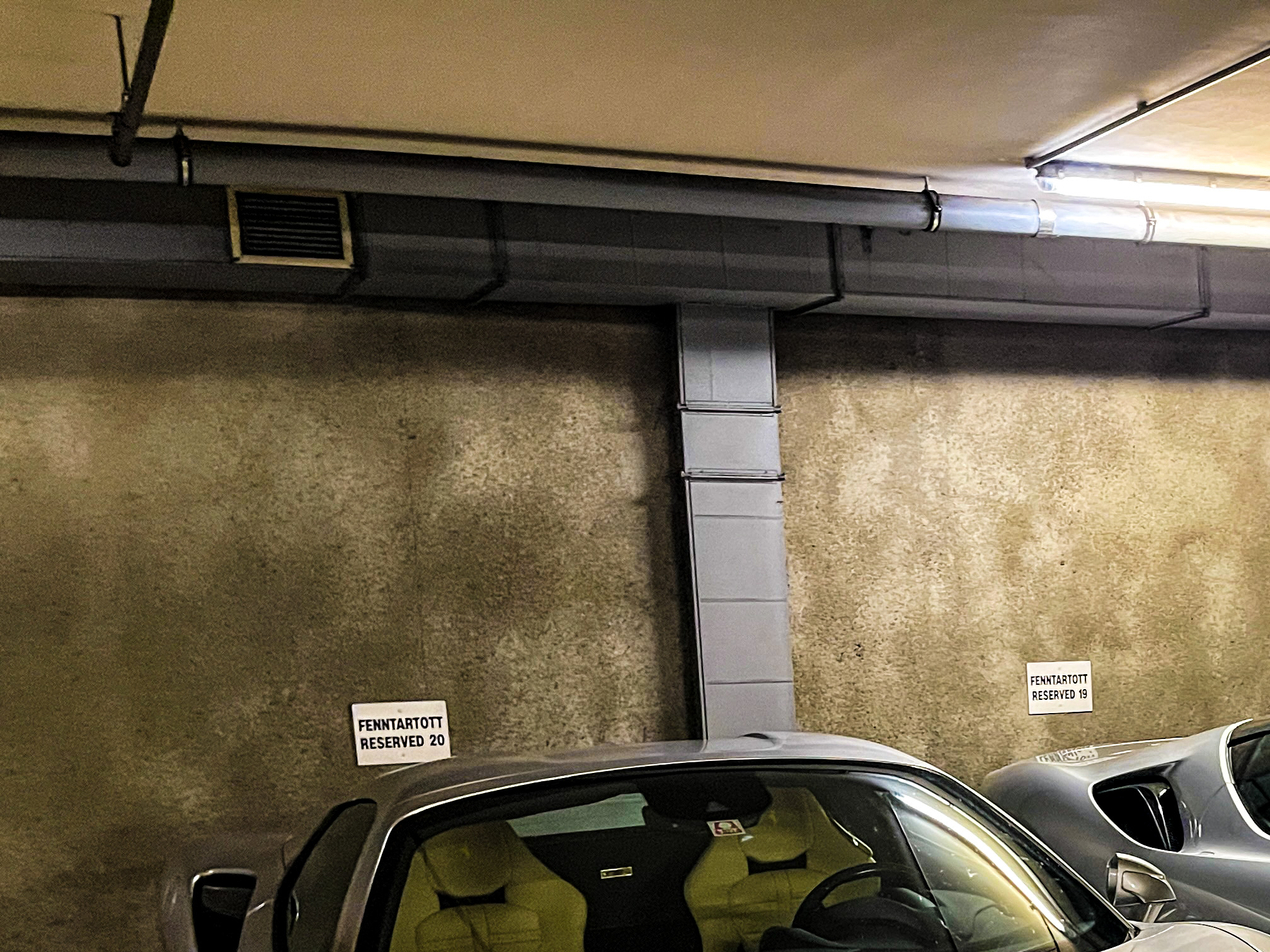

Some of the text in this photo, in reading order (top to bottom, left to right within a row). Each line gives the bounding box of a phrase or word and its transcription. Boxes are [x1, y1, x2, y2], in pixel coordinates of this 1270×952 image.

[1030, 673, 1088, 686] FENNTARTOTT
[1032, 688, 1088, 701] RESERVED 19
[358, 716, 443, 732] FENNTARTOTT
[360, 734, 445, 750] RESERVED 20
